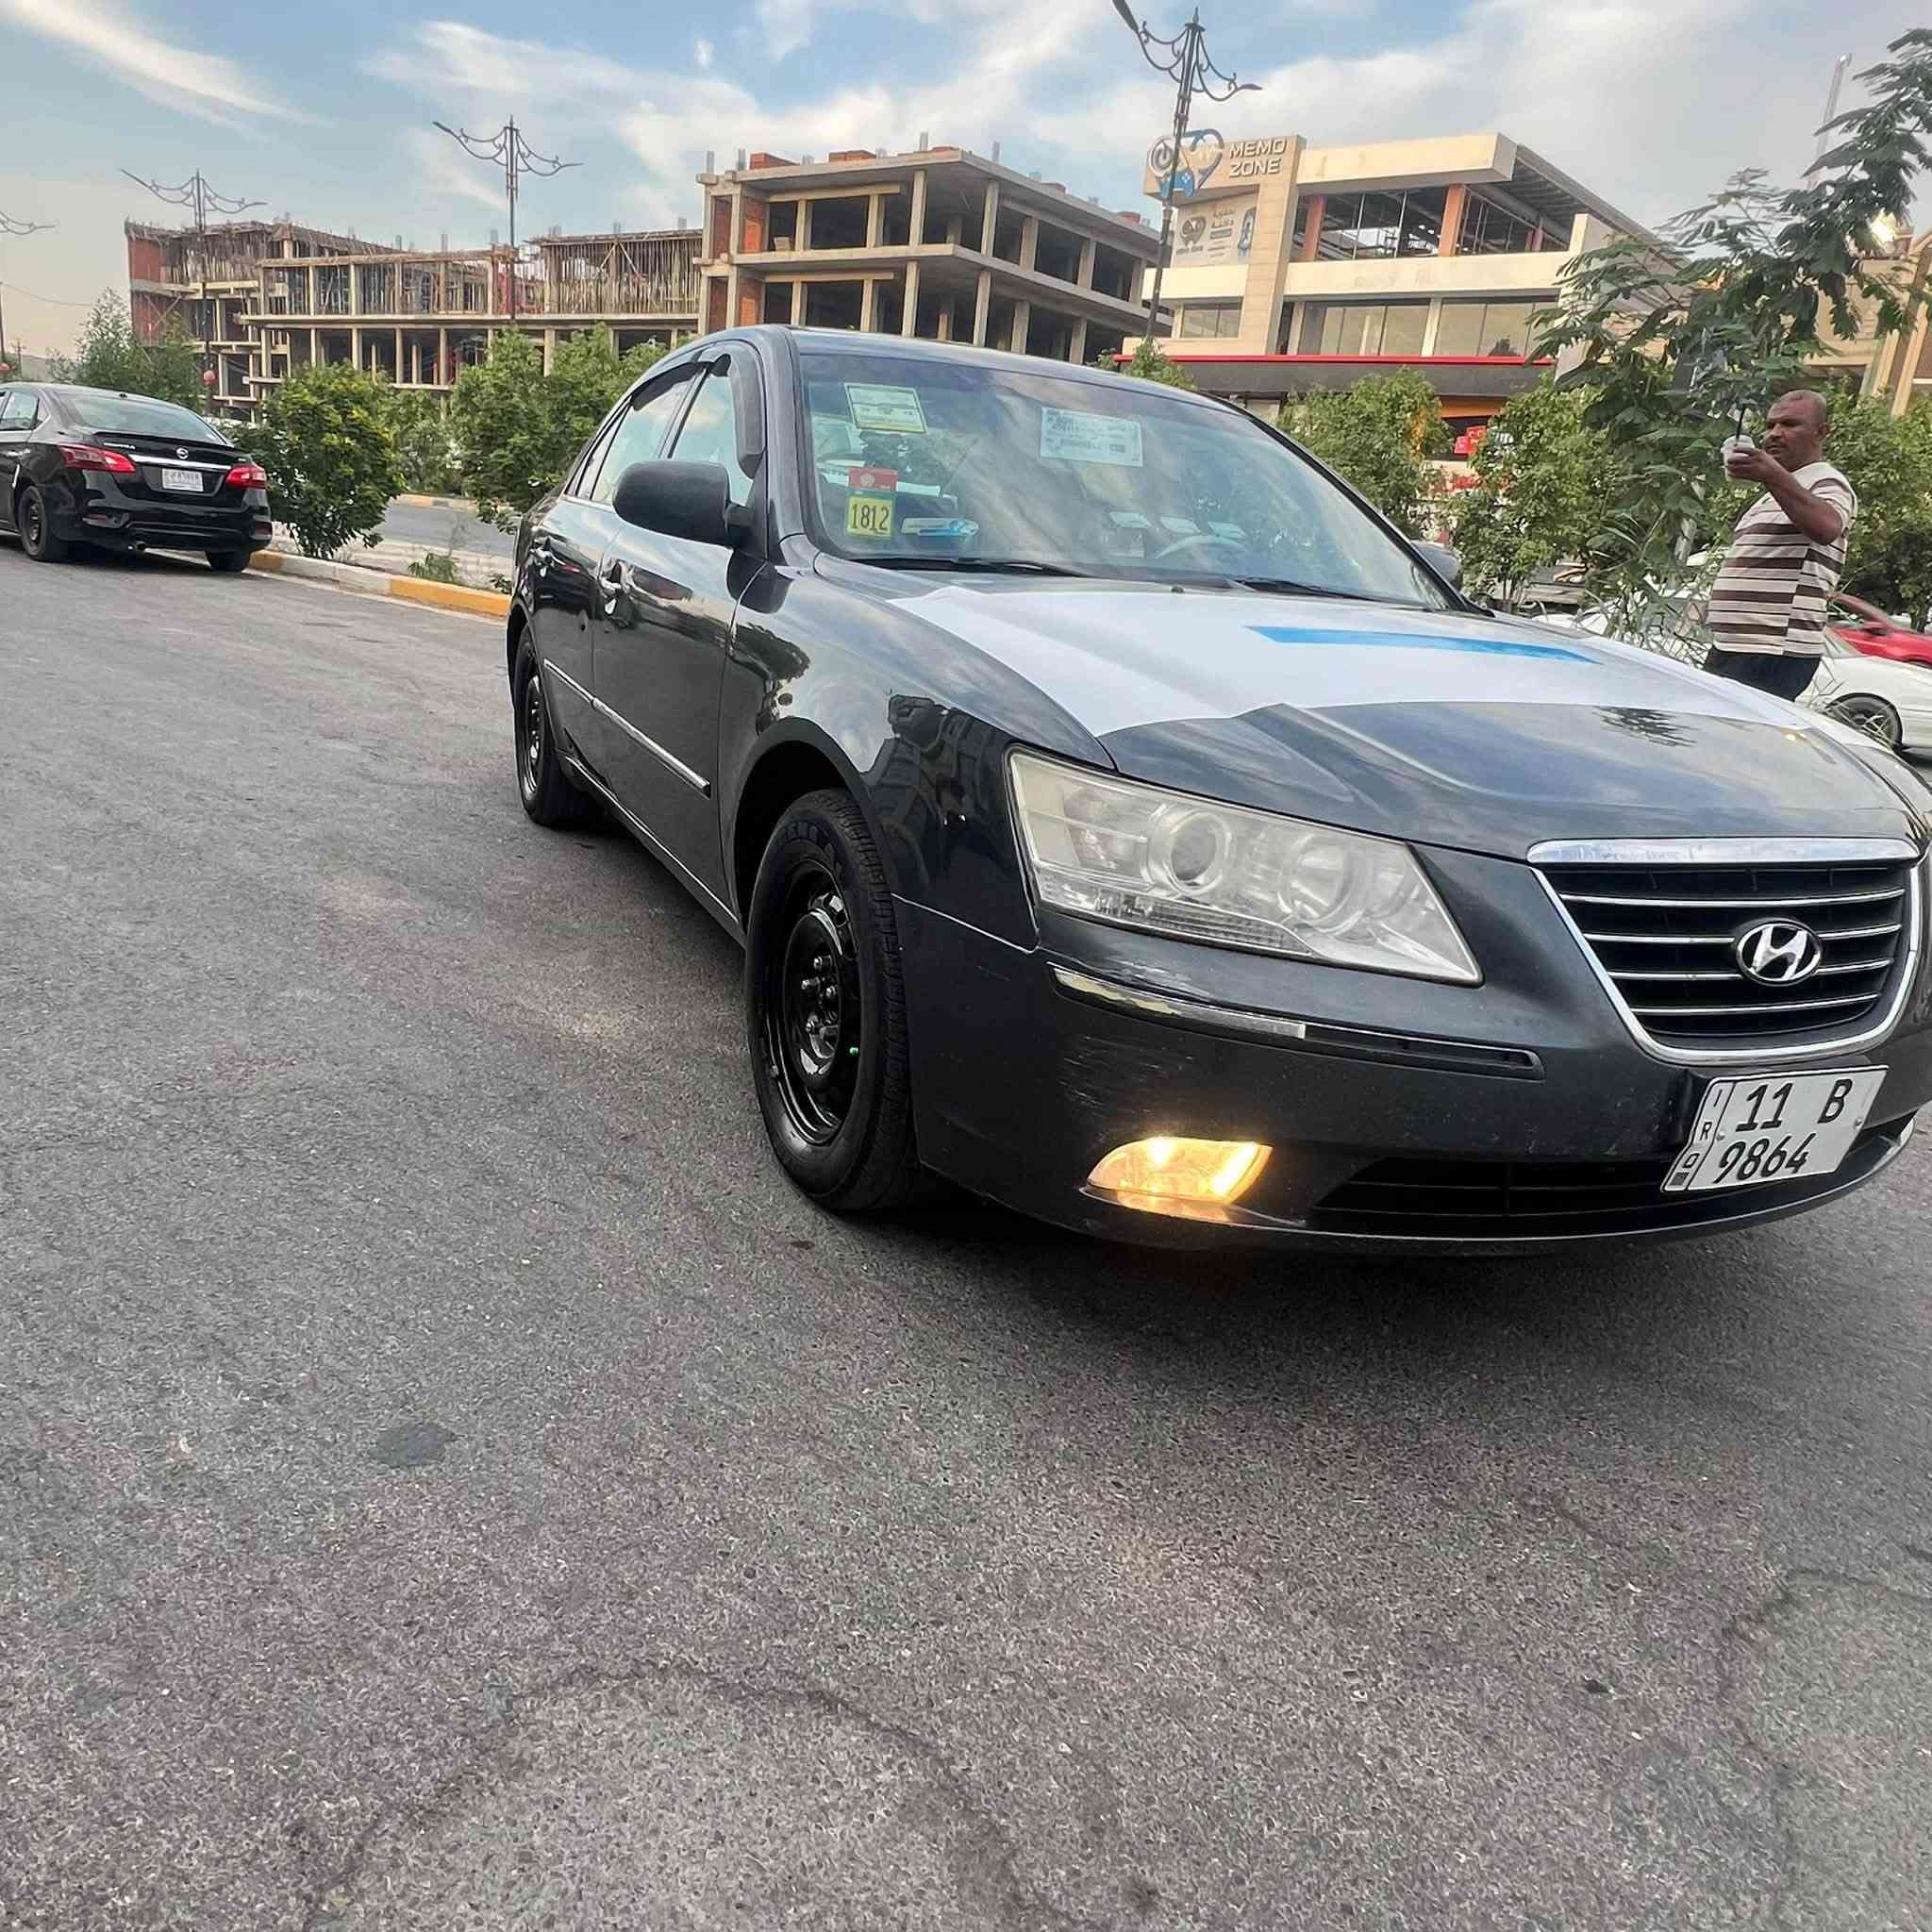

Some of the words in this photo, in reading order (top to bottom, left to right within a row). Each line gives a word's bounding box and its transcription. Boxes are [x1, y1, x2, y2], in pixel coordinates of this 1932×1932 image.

[1229, 137, 1287, 158] MEMO
[1229, 158, 1281, 178] ZONE
[851, 503, 890, 531] 1812
[1735, 1082, 1793, 1132] 11
[1817, 1078, 1854, 1124] B
[1712, 1132, 1817, 1184] 9864
